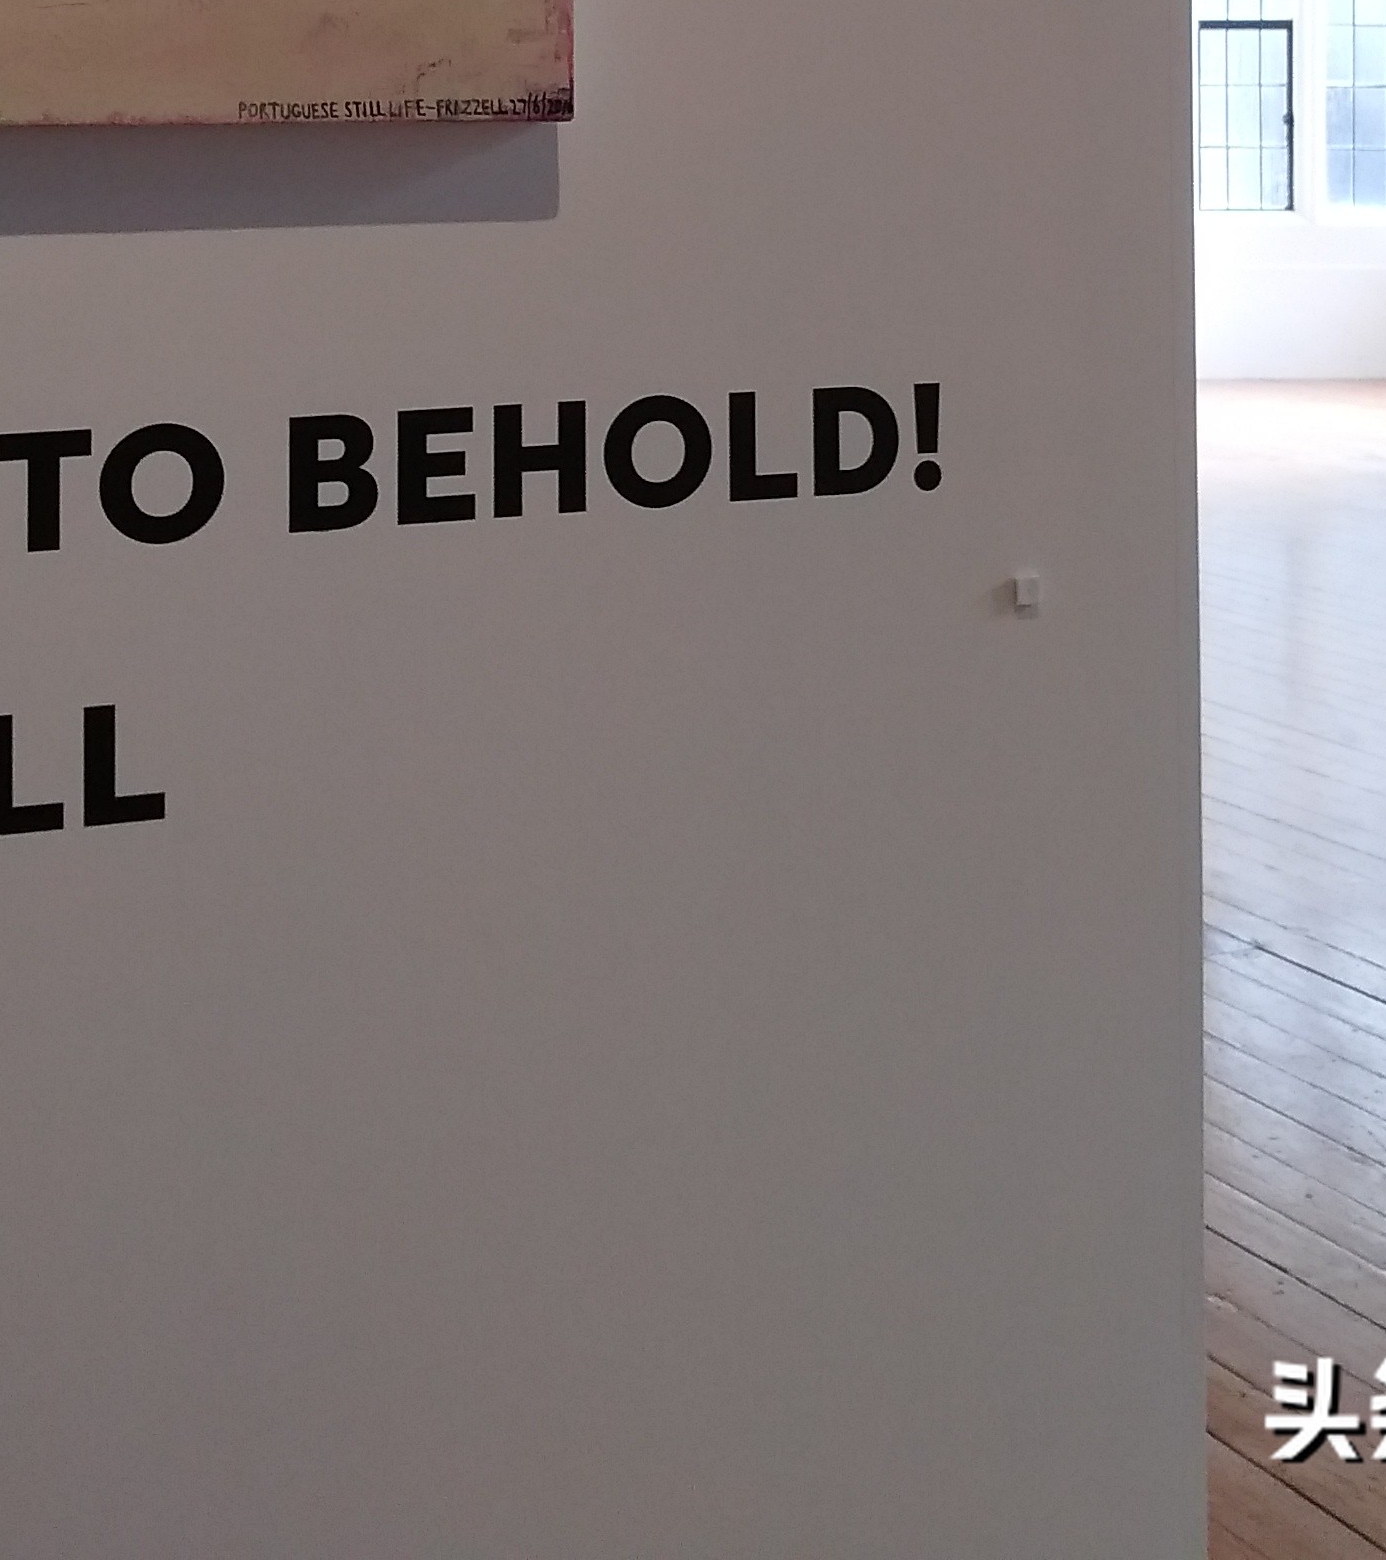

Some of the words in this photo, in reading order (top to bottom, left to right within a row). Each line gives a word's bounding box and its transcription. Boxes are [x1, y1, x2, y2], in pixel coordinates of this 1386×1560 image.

[237, 100, 339, 120] PORTUGUESE
[344, 99, 387, 119] STILL
[287, 381, 943, 535] BEHOLD!
